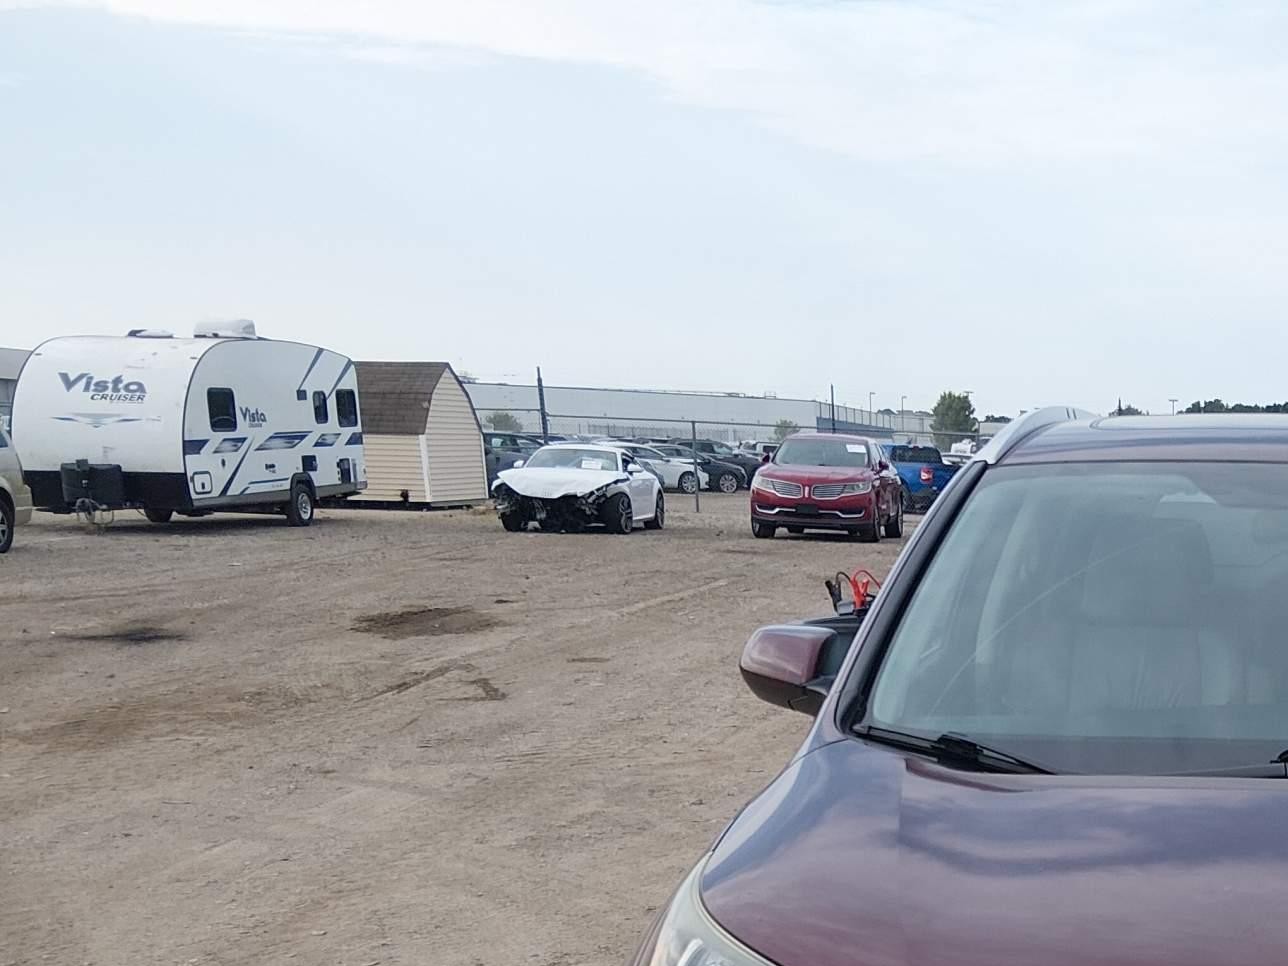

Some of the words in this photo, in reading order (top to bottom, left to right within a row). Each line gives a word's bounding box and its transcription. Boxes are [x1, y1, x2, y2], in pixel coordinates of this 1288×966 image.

[58, 372, 147, 394] Vista
[90, 393, 146, 402] CRUISER
[239, 405, 267, 423] Vista
